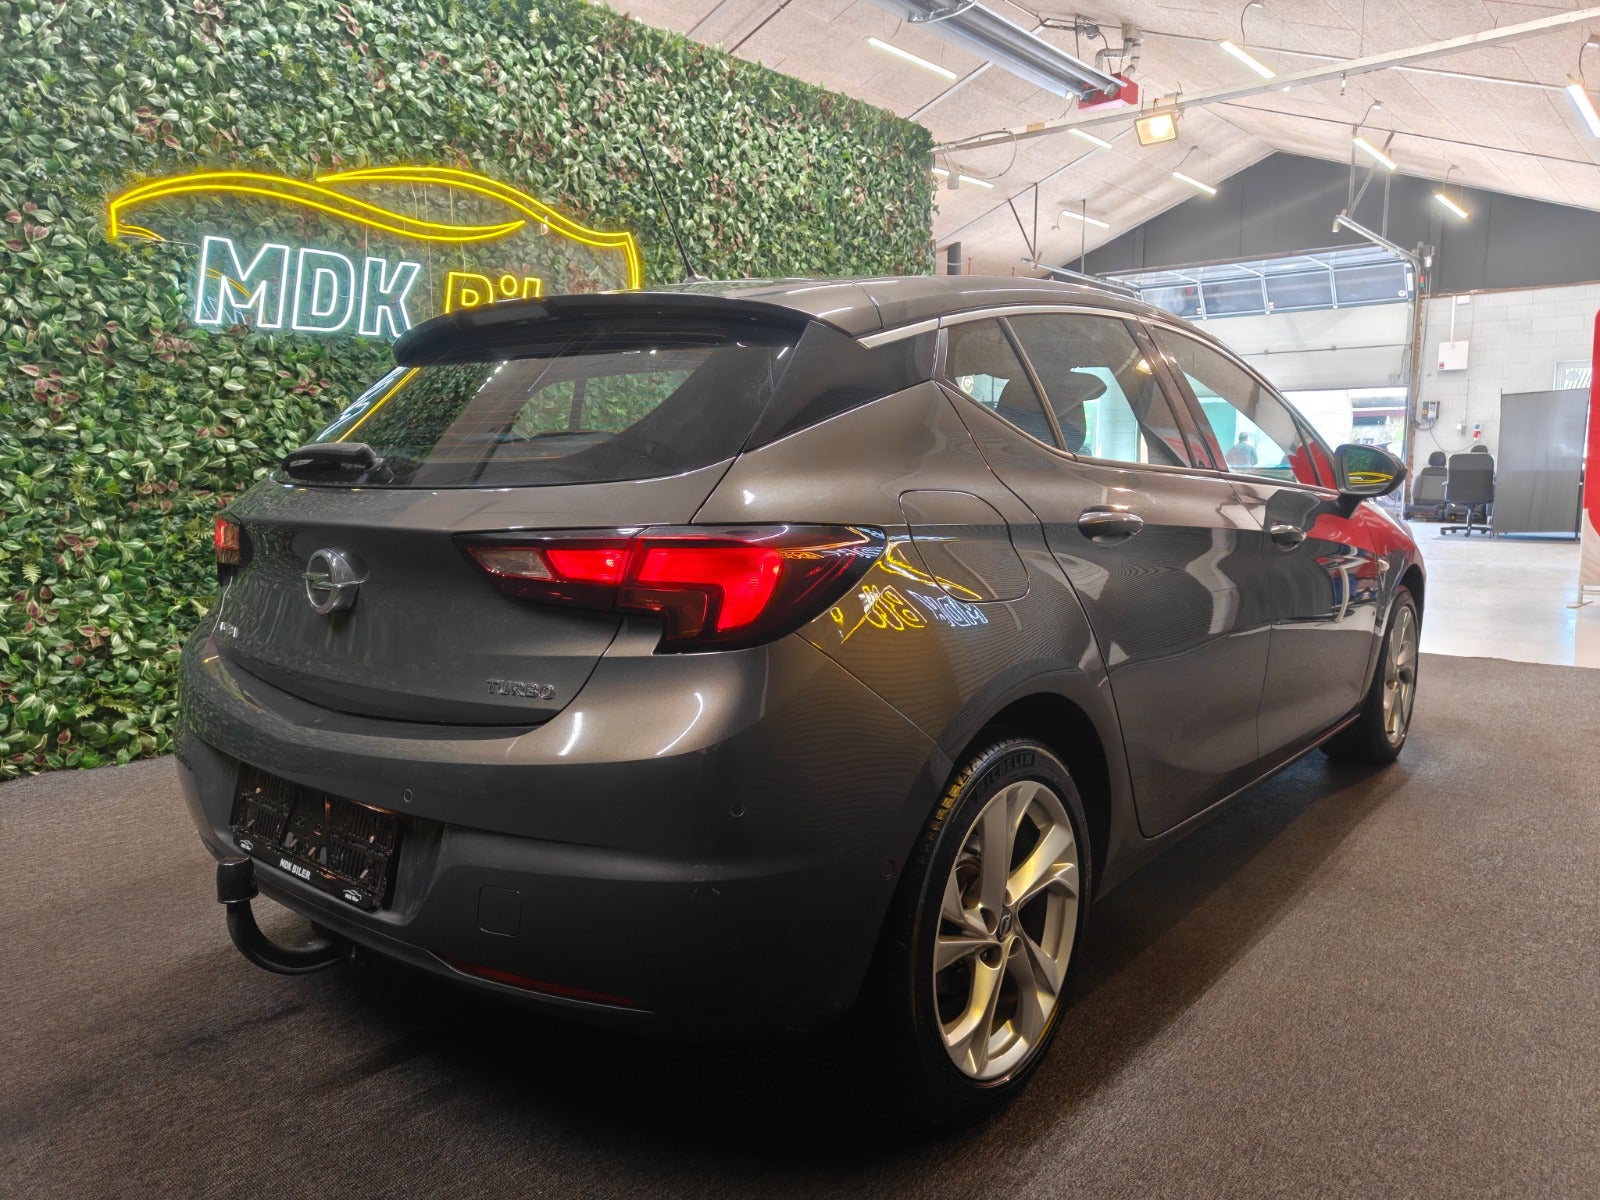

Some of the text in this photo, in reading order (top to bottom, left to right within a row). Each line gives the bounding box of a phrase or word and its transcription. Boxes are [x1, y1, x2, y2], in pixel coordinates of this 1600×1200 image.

[195, 235, 421, 338] MDK
[486, 679, 556, 700] TURBO
[292, 864, 310, 880] BILER
